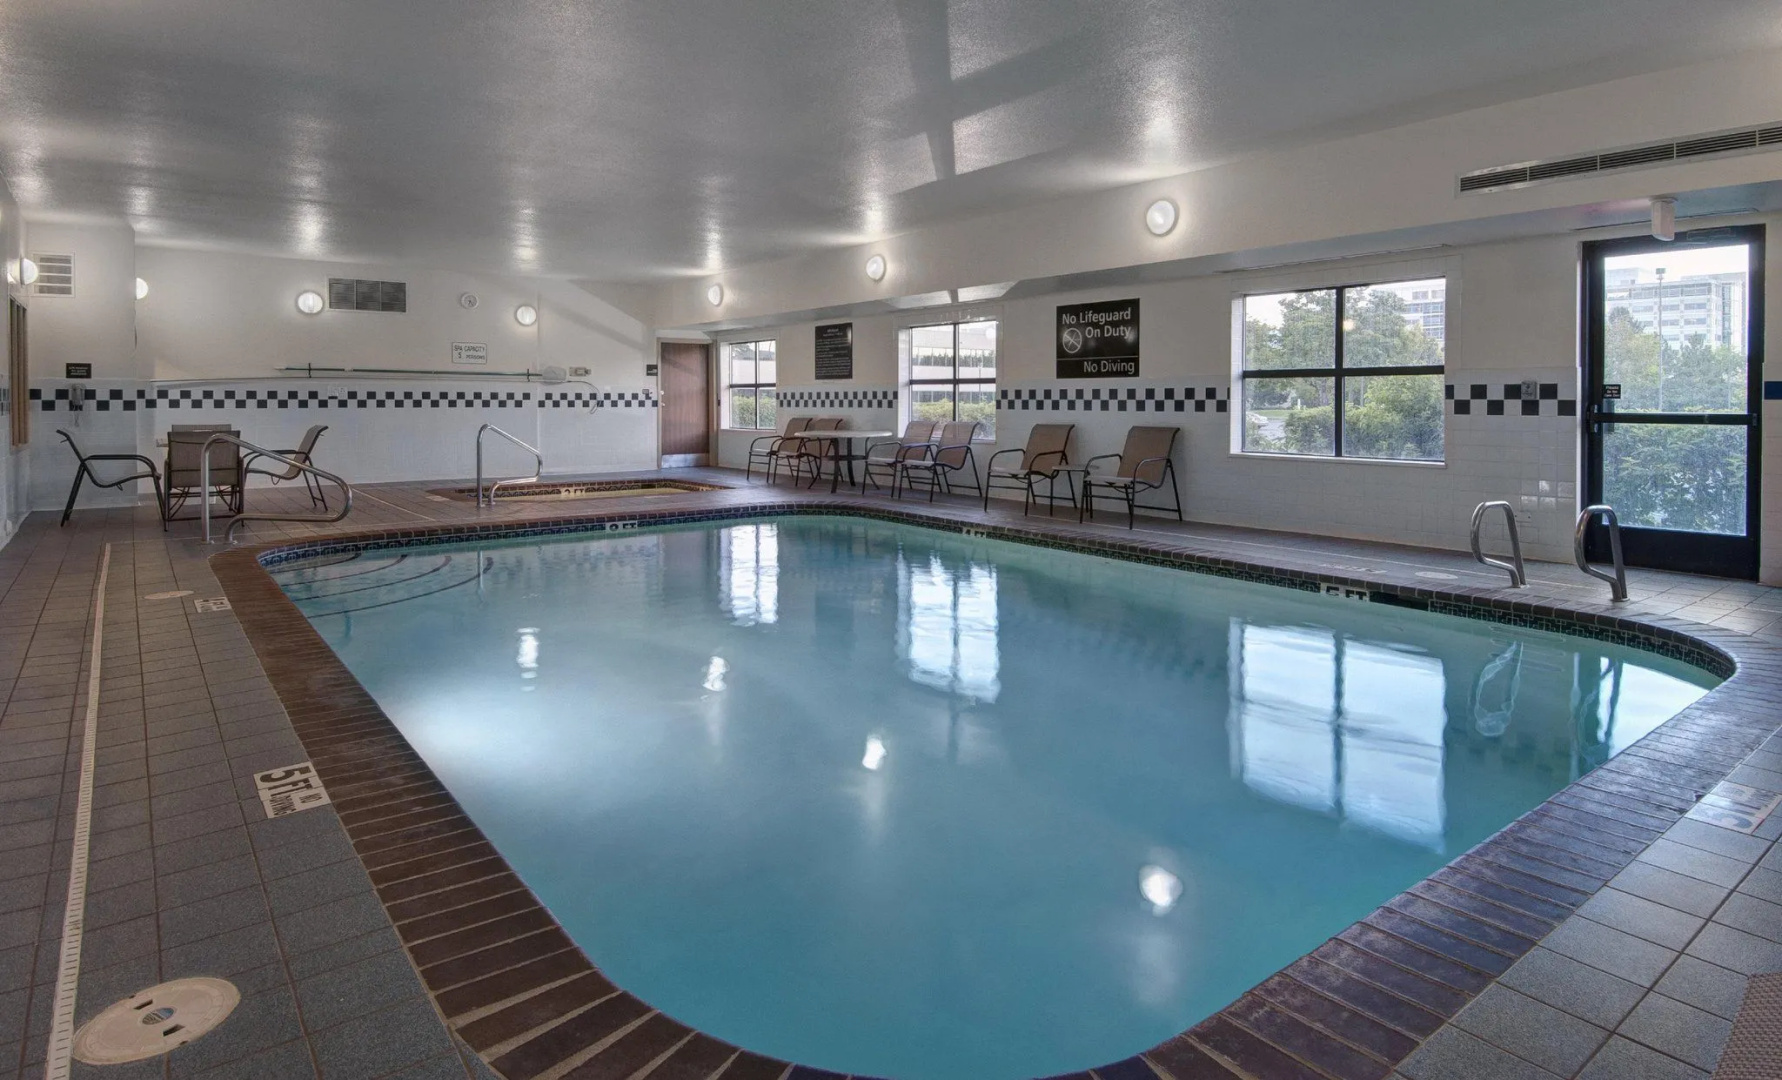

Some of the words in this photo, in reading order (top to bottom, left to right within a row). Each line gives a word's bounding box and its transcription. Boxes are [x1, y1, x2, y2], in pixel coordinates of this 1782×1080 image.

[1062, 313, 1077, 325] No
[1079, 307, 1131, 325] Lifeguard
[1085, 326, 1101, 338] On
[1104, 325, 1131, 339] Duty
[1083, 361, 1098, 372] No
[1100, 359, 1135, 374] Diving
[260, 765, 311, 783] 5
[267, 777, 313, 797] FT
